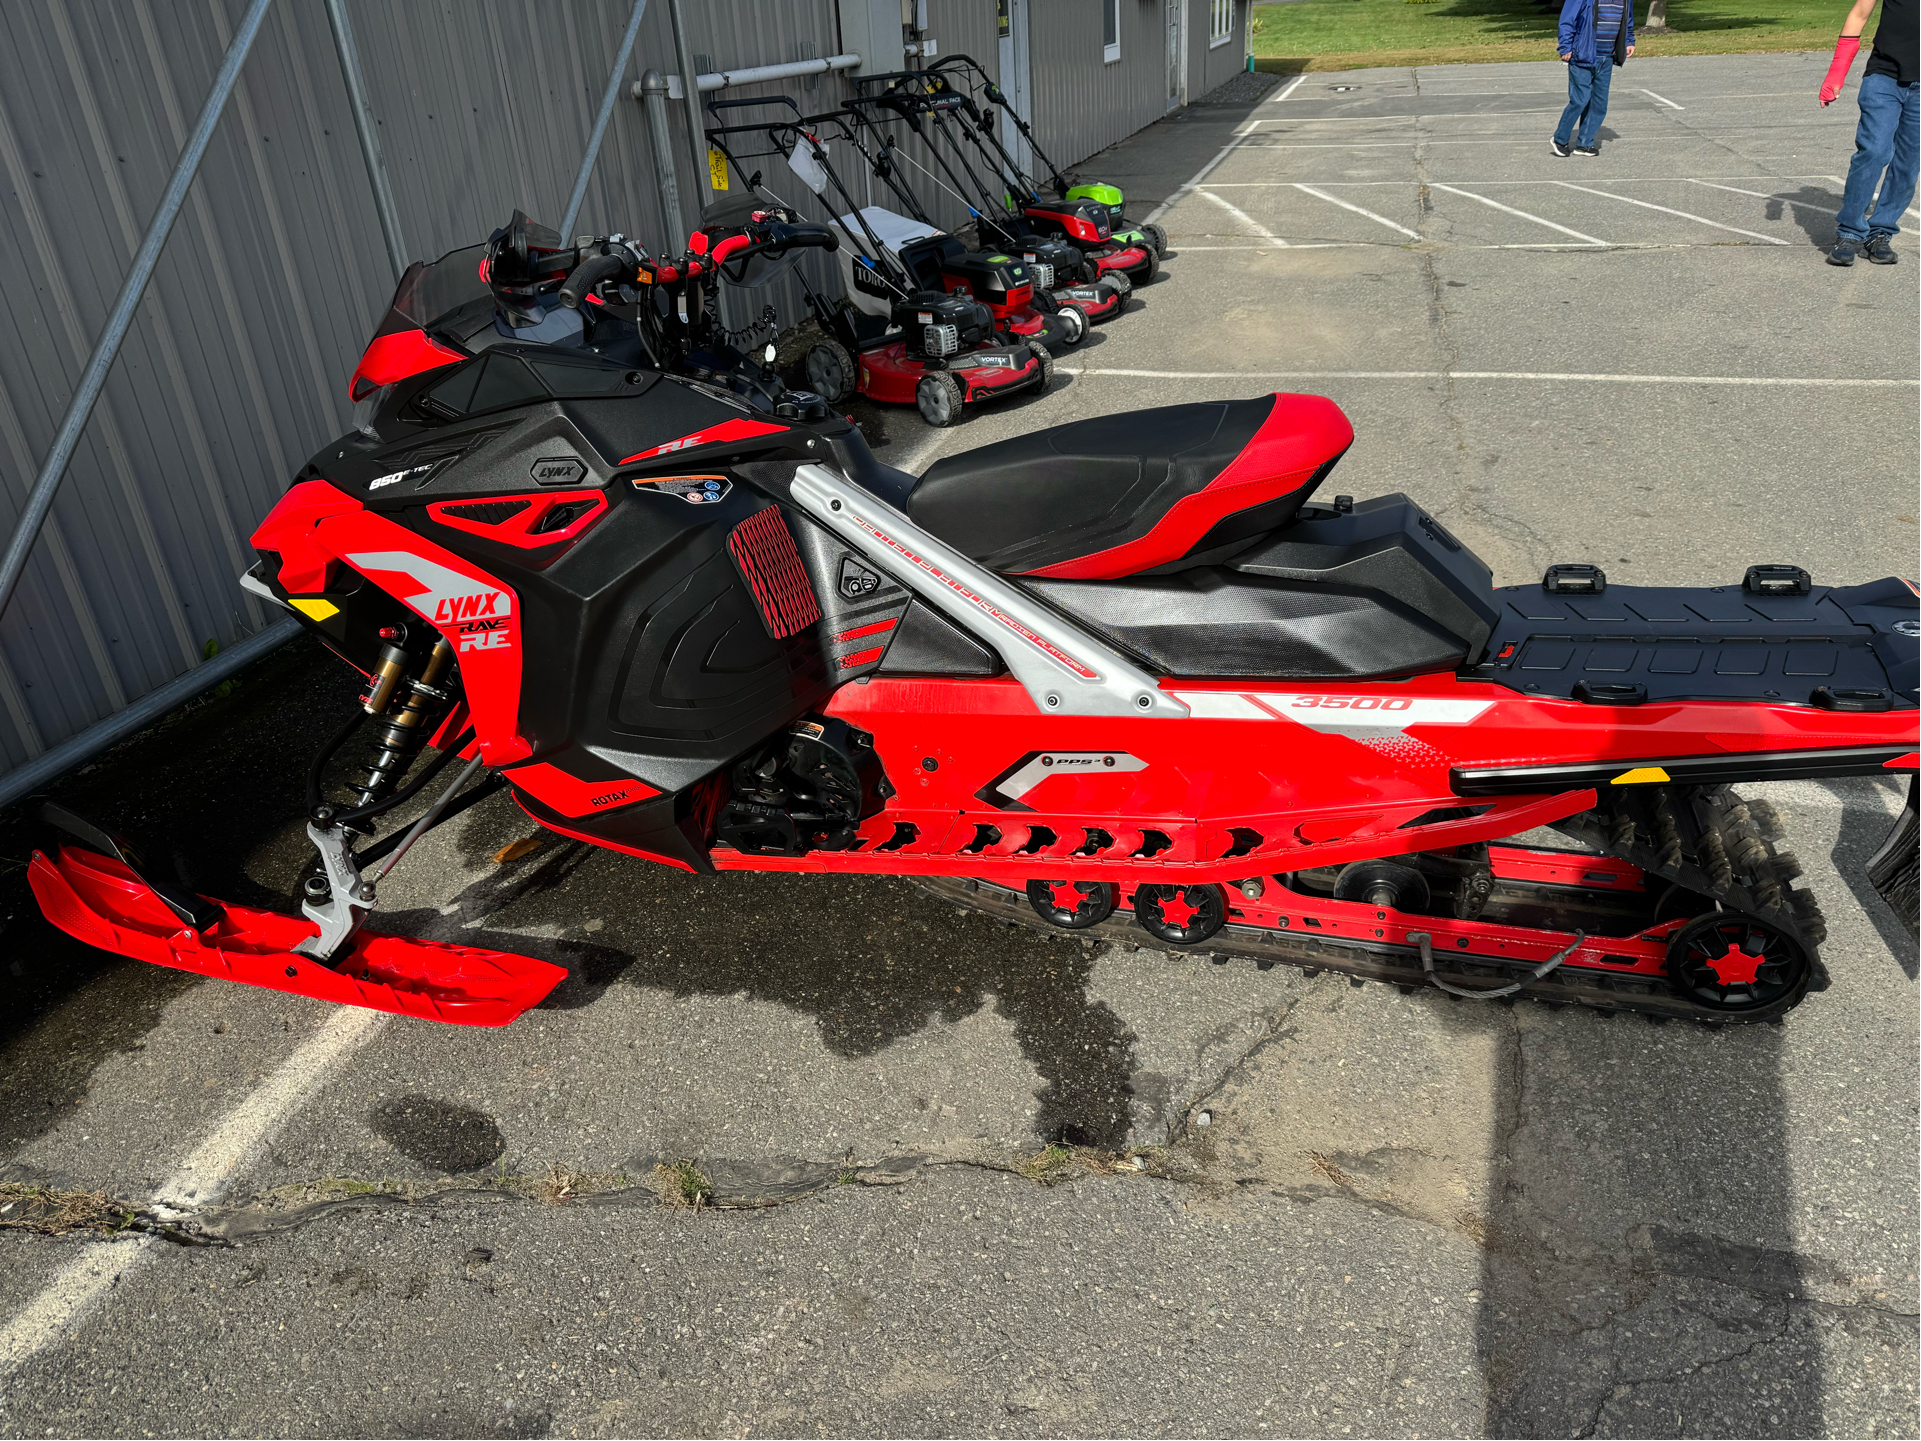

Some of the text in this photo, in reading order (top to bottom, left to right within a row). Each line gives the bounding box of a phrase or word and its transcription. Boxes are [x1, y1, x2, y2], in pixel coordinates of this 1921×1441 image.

[981, 356, 1006, 364] VORTEX
[657, 435, 702, 455] RE
[368, 463, 433, 490] 850 E-TEC
[538, 465, 577, 479] LYNX
[434, 591, 501, 623] LYNX
[446, 617, 511, 634] RAVE
[459, 629, 512, 653] RE
[1036, 637, 1086, 673] PLATFORM
[1291, 695, 1414, 711] 3500
[590, 790, 630, 807] ROTAX
